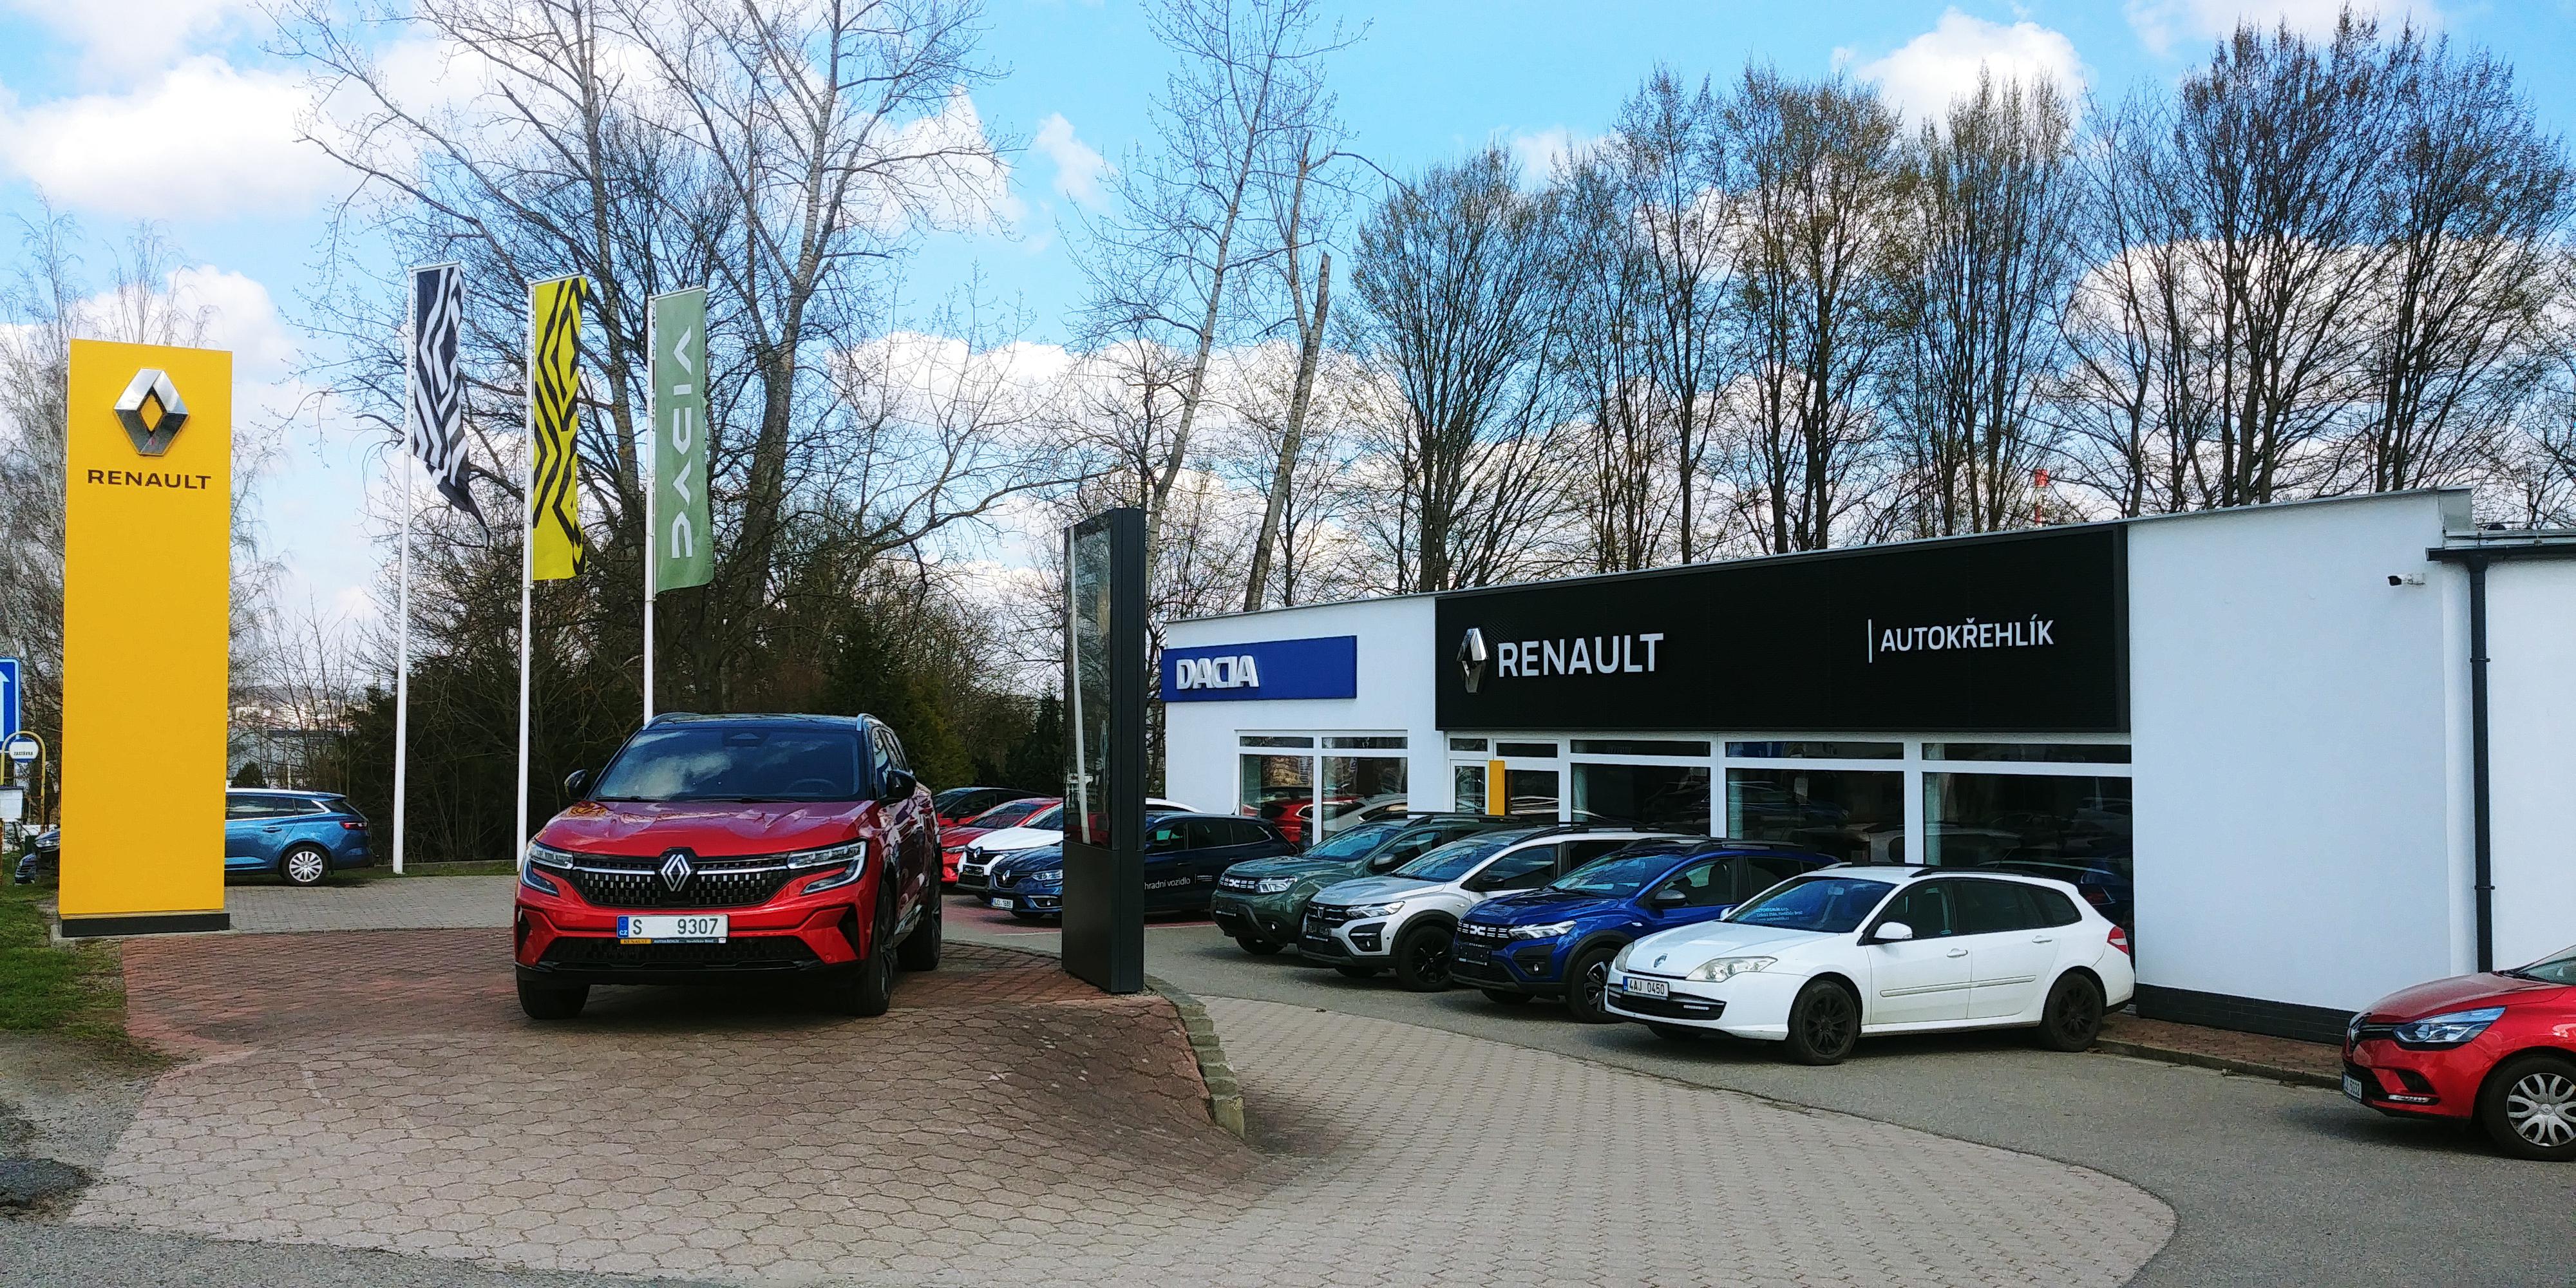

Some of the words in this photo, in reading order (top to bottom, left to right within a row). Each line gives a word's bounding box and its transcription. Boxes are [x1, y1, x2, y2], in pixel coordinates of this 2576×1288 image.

[670, 325, 692, 558] DACIA
[87, 468, 212, 490] RENAULT
[1880, 614, 2054, 653] AUTOKŘEHLÍK
[1498, 632, 1664, 677] RENAULT
[1175, 655, 1260, 690] DACIA
[1144, 880, 1166, 890] hradní
[1167, 876, 1191, 887] vozidlo
[632, 919, 643, 935] S
[677, 918, 719, 934] 9307
[1629, 980, 1642, 992] 4AJ
[1647, 982, 1665, 995] 0450
